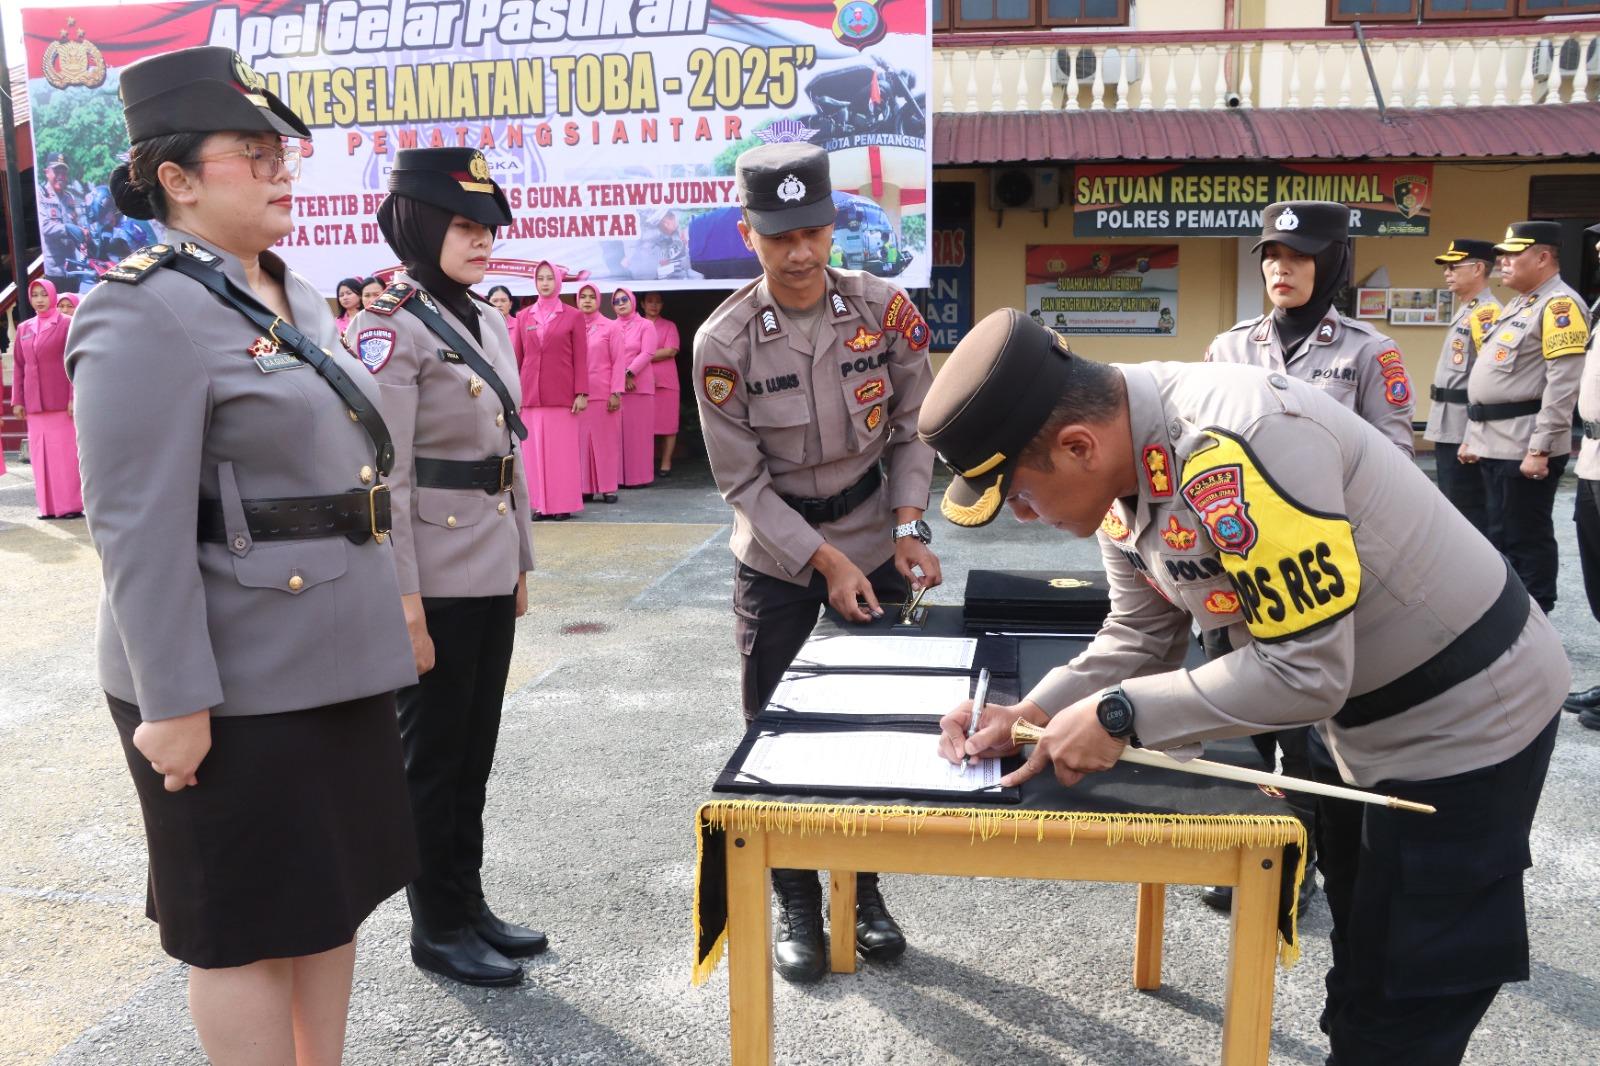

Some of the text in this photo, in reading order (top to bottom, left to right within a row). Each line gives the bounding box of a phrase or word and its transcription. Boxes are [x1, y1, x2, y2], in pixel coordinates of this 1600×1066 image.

[207, 0, 706, 68] Apel Gelar Pasukan
[287, 57, 545, 128] KESELAMATAN
[551, 51, 659, 116] TOBA
[347, 115, 743, 156] PEMATANGSIANTAR
[294, 194, 358, 217] TERTIB
[526, 185, 582, 209] GUNA
[587, 179, 742, 207] TERWUJUDNY
[1077, 175, 1384, 205] SATUAN RESERSE KRIMINAL
[314, 223, 357, 246] CITA
[361, 222, 379, 245] DI
[1096, 210, 1170, 229] POLRES
[1311, 367, 1357, 381] POLRI
[1189, 472, 1232, 496] POLRES
[1279, 542, 1345, 614] RES
